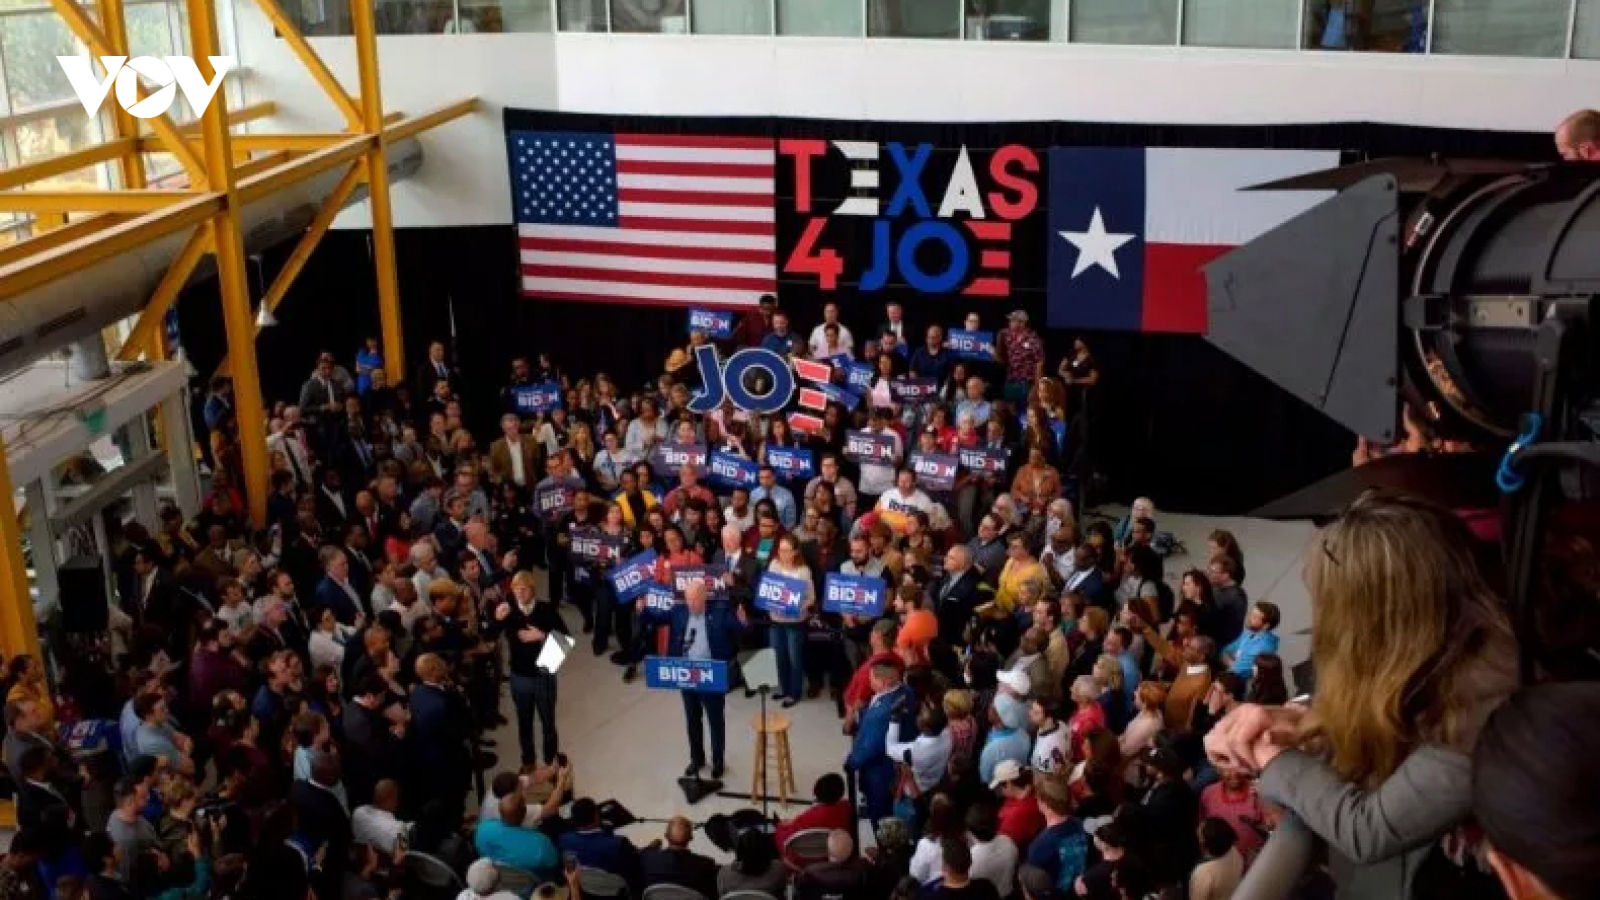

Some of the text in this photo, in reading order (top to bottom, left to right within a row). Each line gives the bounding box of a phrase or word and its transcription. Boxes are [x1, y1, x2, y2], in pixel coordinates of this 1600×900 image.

[779, 138, 1040, 220] TEXAS
[783, 217, 1012, 296] 4 JOE
[686, 344, 831, 434] JOE
[665, 452, 706, 465] BIDEN
[849, 441, 892, 458] BIDEN
[769, 453, 811, 469] BIDEN
[915, 459, 955, 477] BIDEN
[960, 453, 1005, 470] BIDEN
[712, 461, 756, 483] BIDEN
[573, 540, 619, 558] BIDEN
[759, 583, 801, 605] BIDEN
[828, 585, 878, 604] BIDEN
[658, 666, 714, 684] BIDEN
